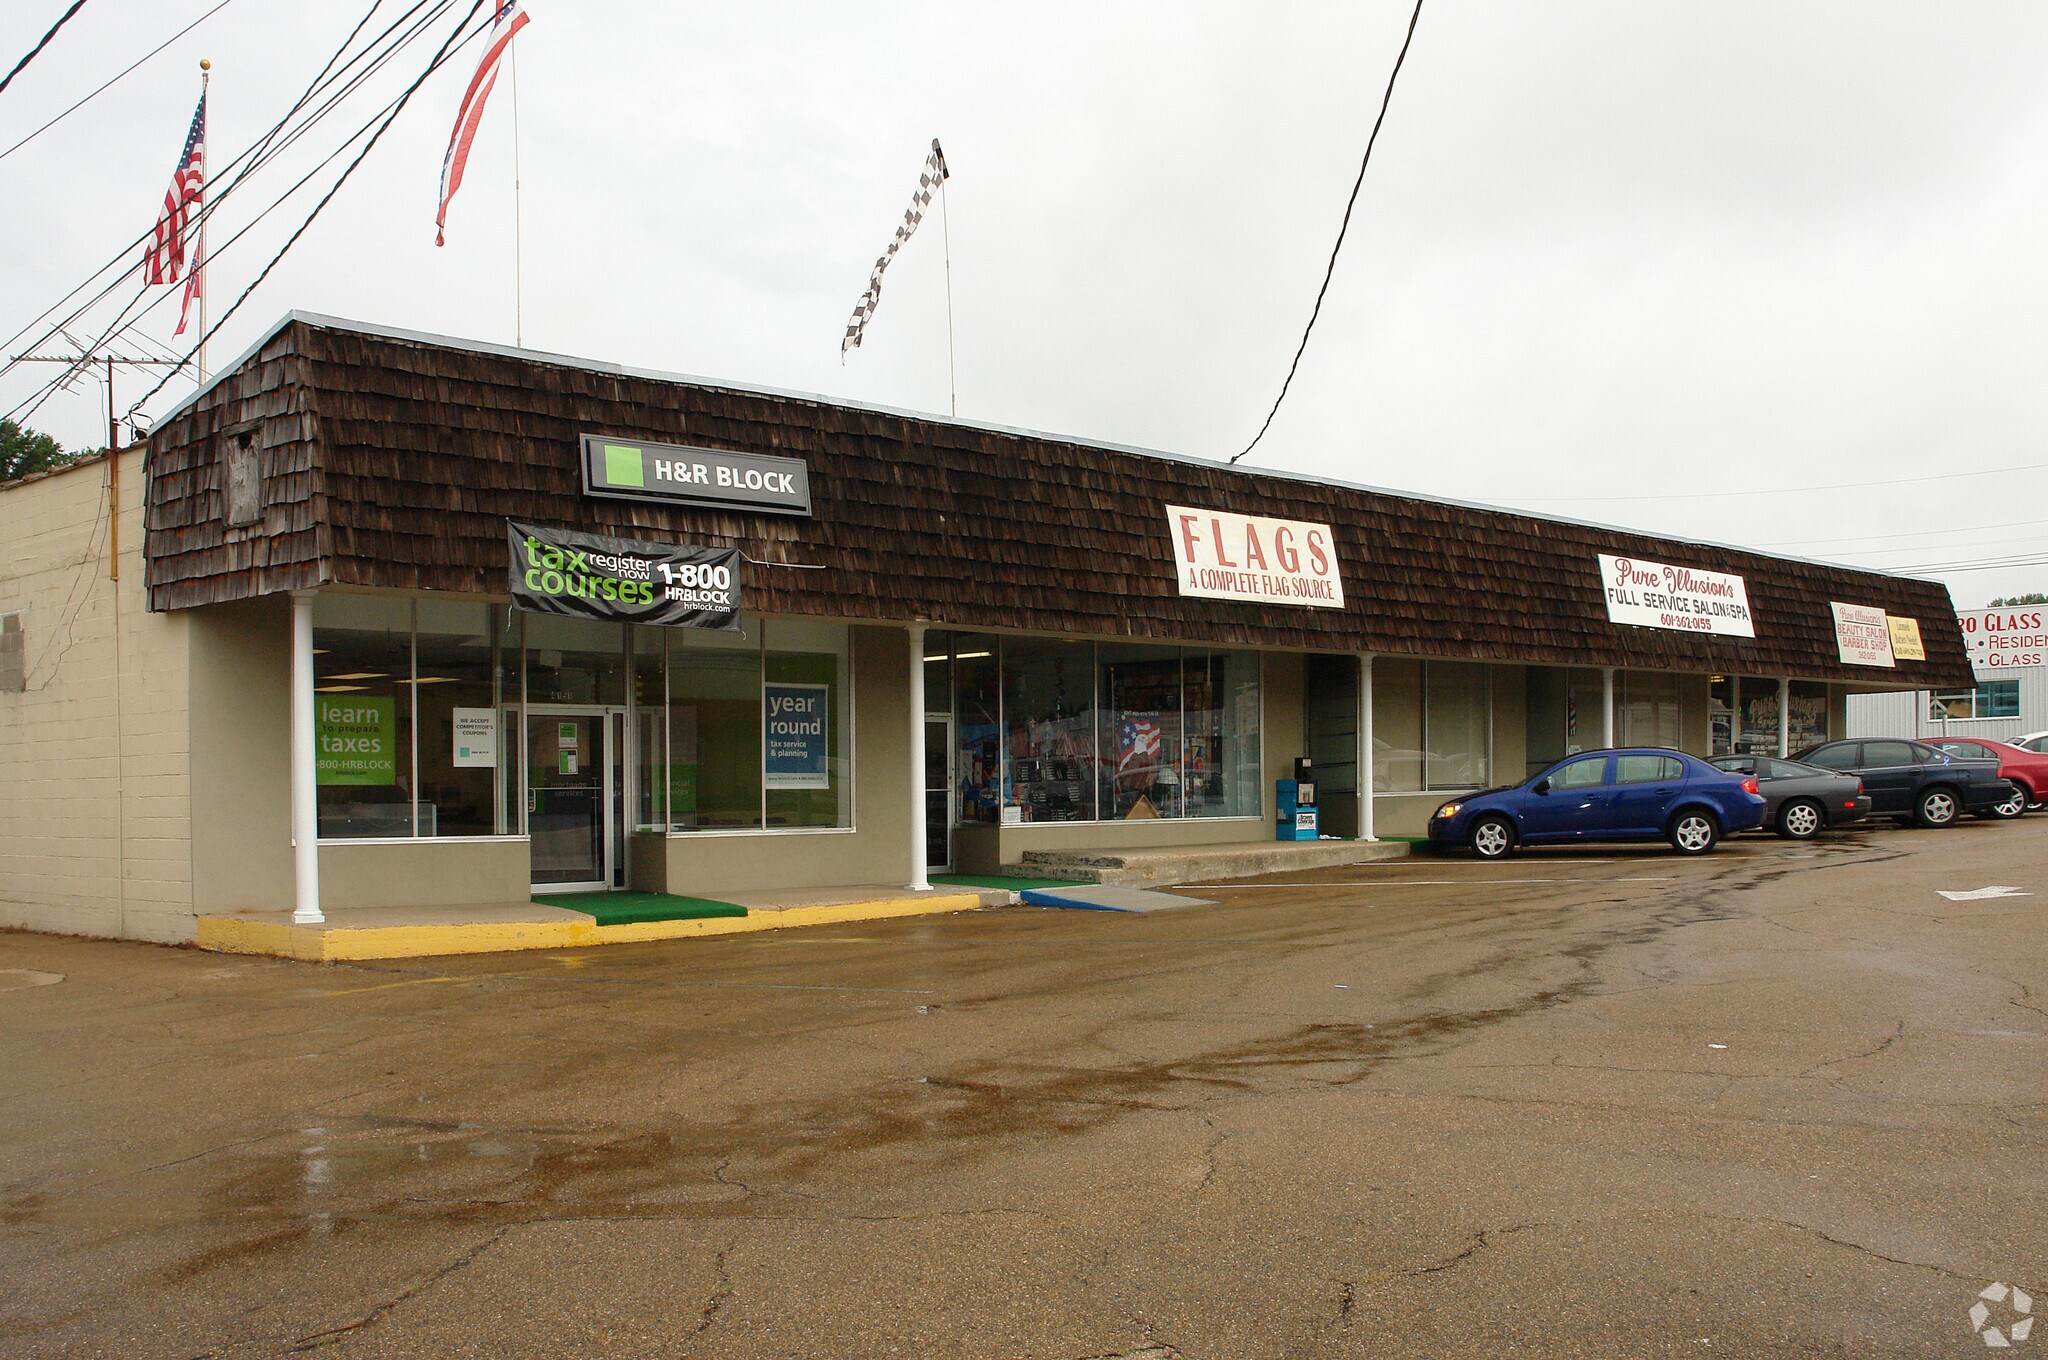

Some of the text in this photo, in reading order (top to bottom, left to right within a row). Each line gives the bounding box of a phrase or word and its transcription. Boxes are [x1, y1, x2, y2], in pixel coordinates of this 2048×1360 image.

[655, 459, 796, 494] H&R BLOCK
[523, 535, 590, 573] tax
[1179, 514, 1329, 576] FLAGS
[589, 552, 652, 572] register
[618, 568, 650, 580] now
[657, 563, 731, 590] 1-800
[1189, 567, 1335, 600] A COMPLETE FLAG SOURCE
[1614, 558, 1734, 599] Pure Illusion's
[525, 568, 653, 605] courses
[664, 586, 730, 605] HRBLOCK
[684, 602, 731, 613] hrblock.com
[1607, 587, 1640, 607] FULL
[1643, 592, 1691, 613] SERVICE
[1660, 613, 1712, 630] 601-362-0155
[1837, 623, 1887, 639] BEAUTY SALON
[1984, 613, 2041, 632] GLASS
[1843, 637, 1869, 649] BARBER
[1870, 640, 1887, 651] SHOP
[1989, 653, 2041, 667] GLASS
[322, 701, 379, 723] learn
[770, 696, 815, 717] year
[770, 718, 821, 735] round
[321, 734, 381, 753] taxes
[783, 740, 807, 748] service
[770, 749, 808, 759] & planning
